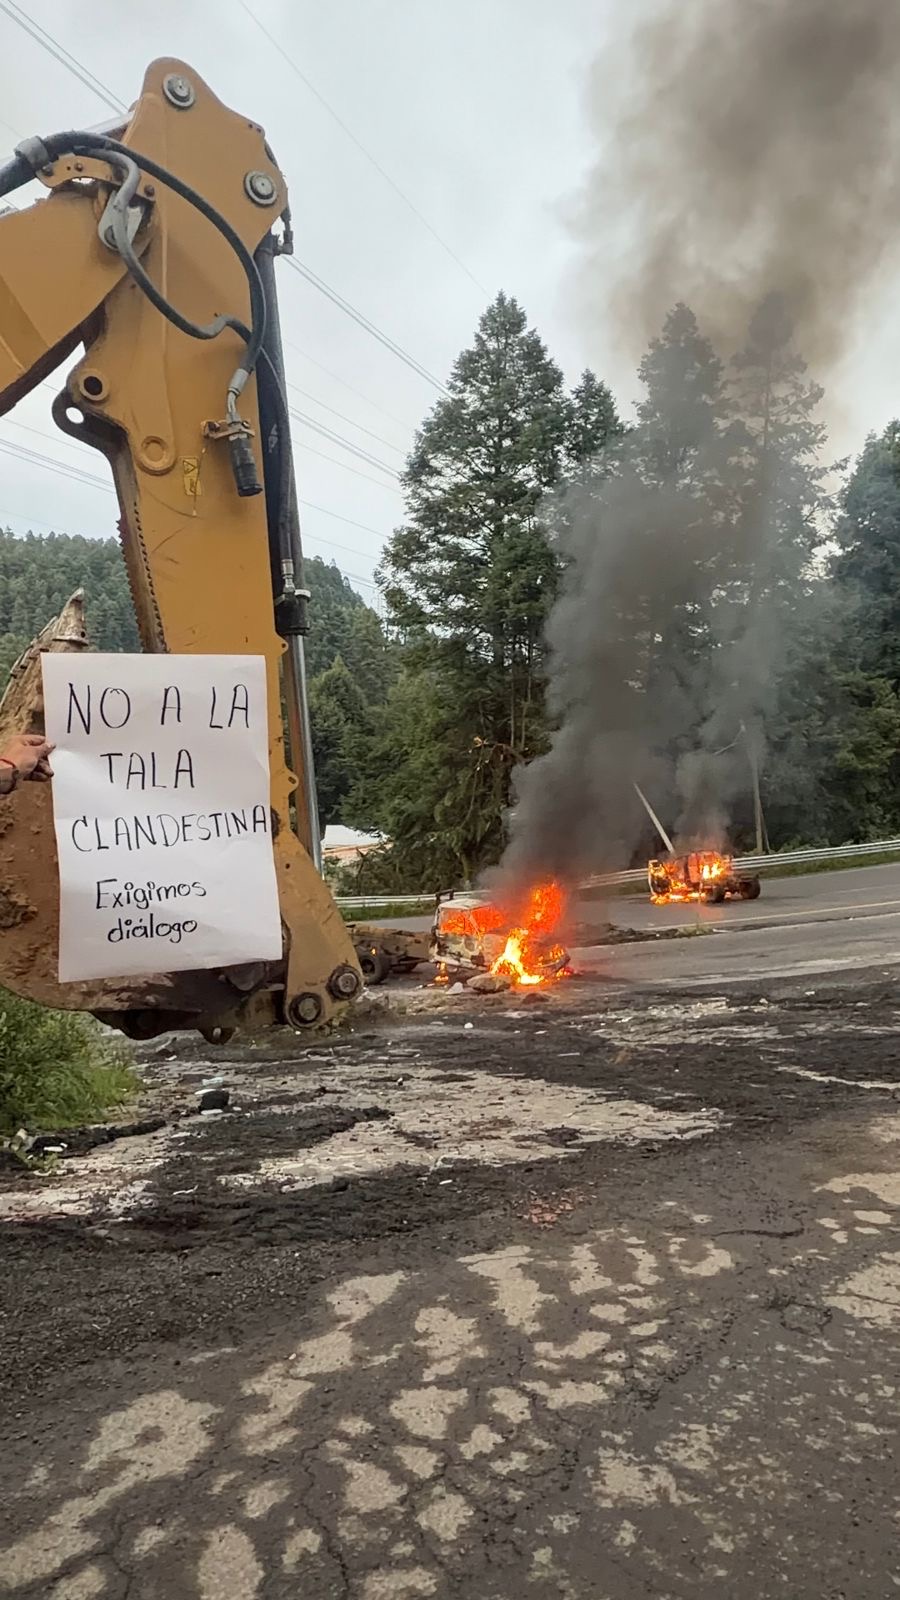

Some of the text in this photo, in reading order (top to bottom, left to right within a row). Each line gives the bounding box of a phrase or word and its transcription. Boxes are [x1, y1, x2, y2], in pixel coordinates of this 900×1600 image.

[67, 683, 249, 735] NO A LA
[100, 749, 194, 789] TALA
[71, 804, 268, 852] CLANDESTINA
[96, 878, 208, 910] Exigimos
[107, 912, 198, 945] diálogo
